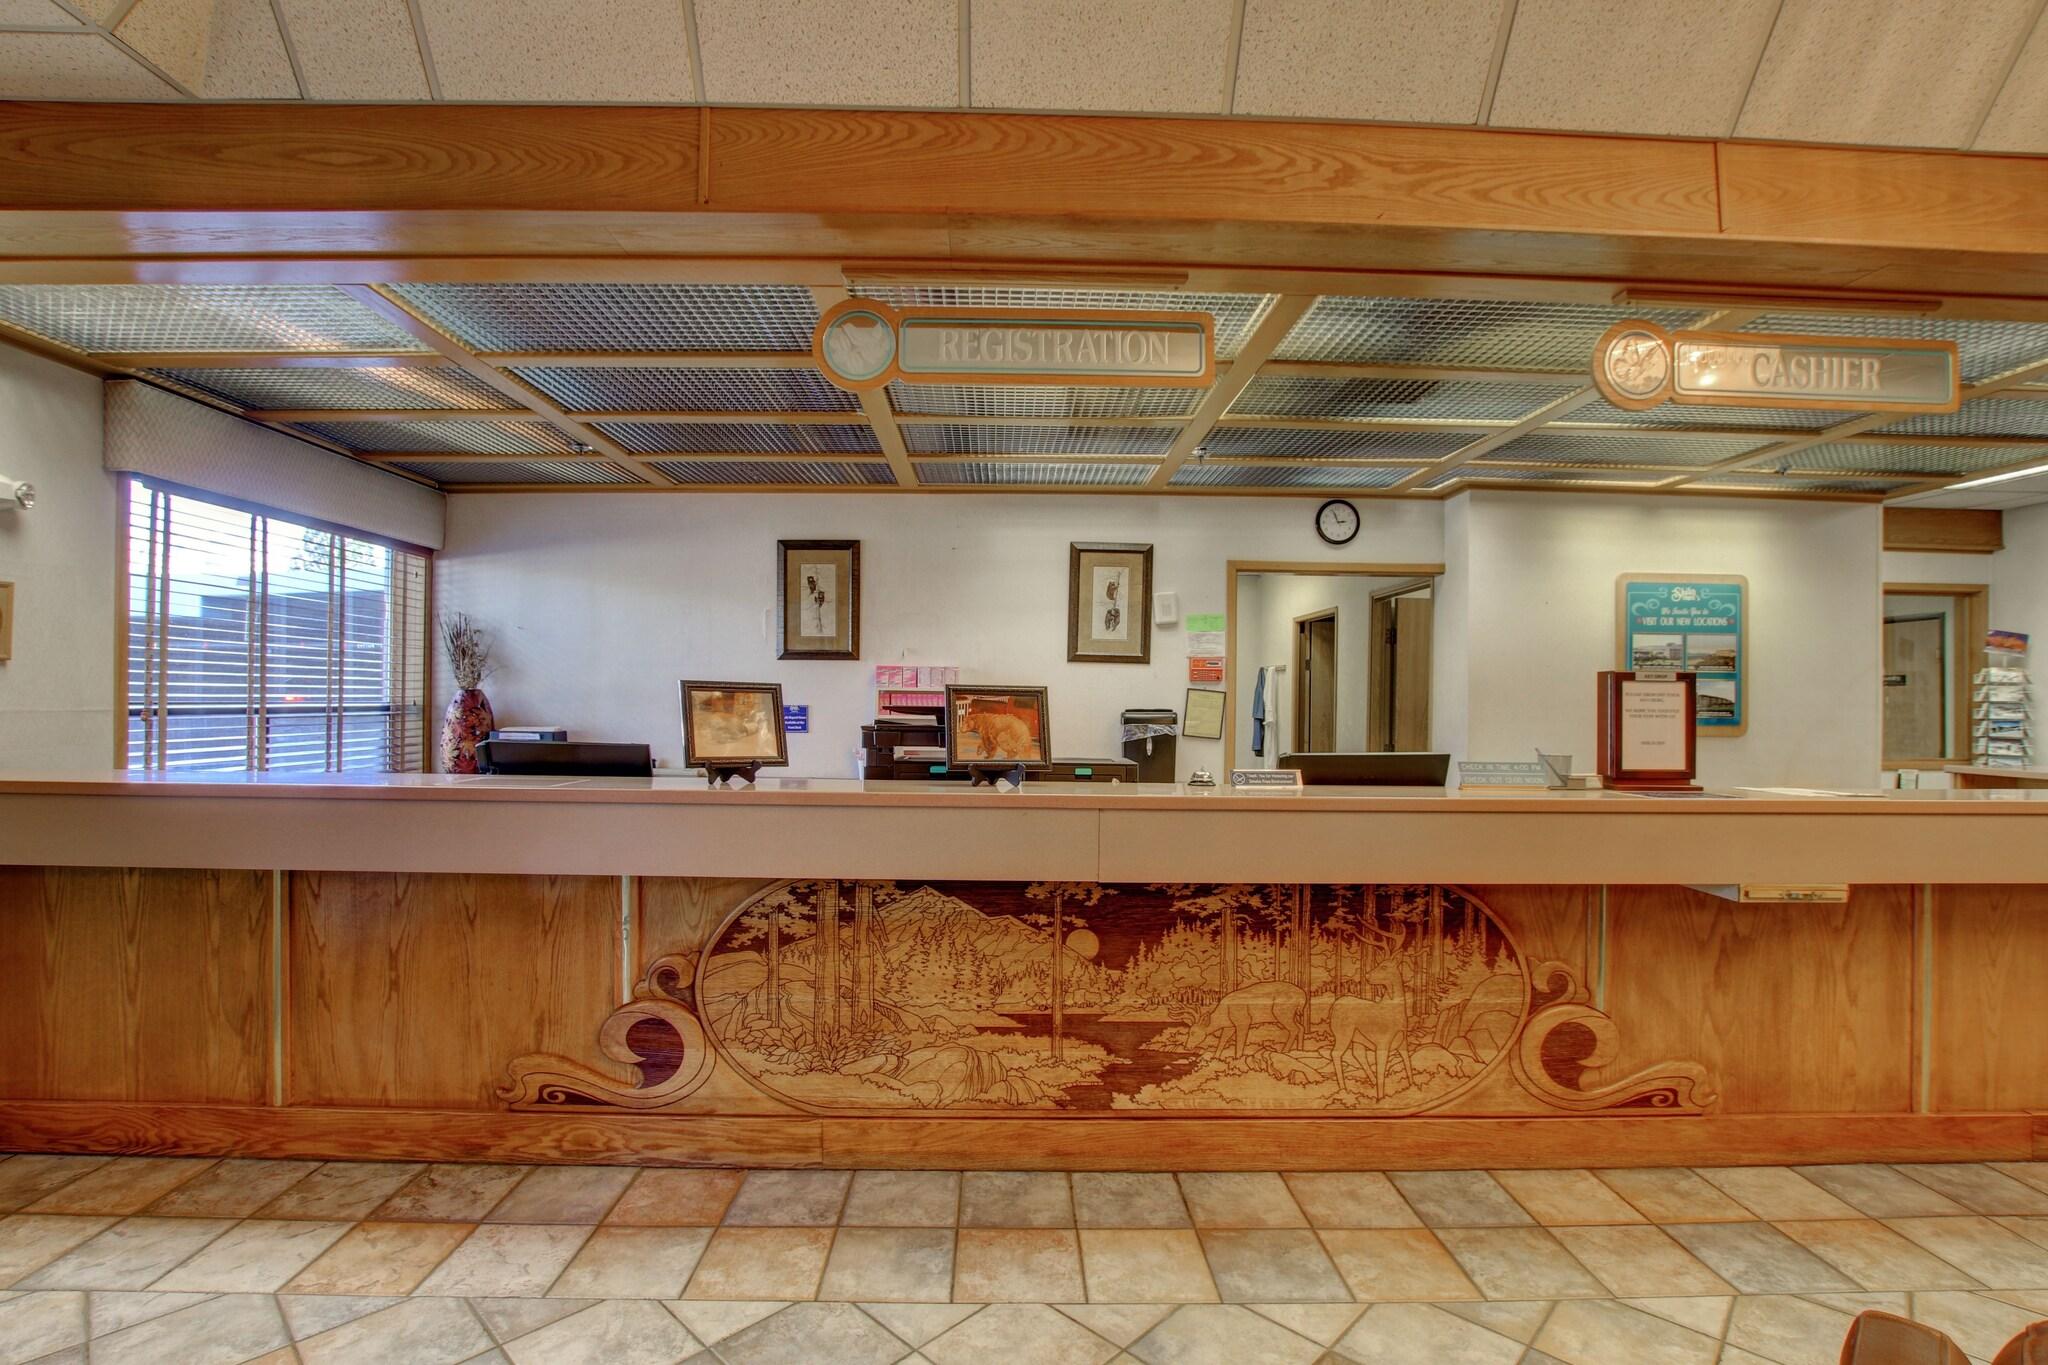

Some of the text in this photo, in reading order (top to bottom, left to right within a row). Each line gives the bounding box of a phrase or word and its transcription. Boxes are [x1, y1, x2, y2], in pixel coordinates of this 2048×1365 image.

[937, 327, 1170, 364] REGISTRATION
[1750, 351, 1881, 391] CASHIER
[1642, 616, 1728, 627] VISIT OUR NEW LOCATIONS
